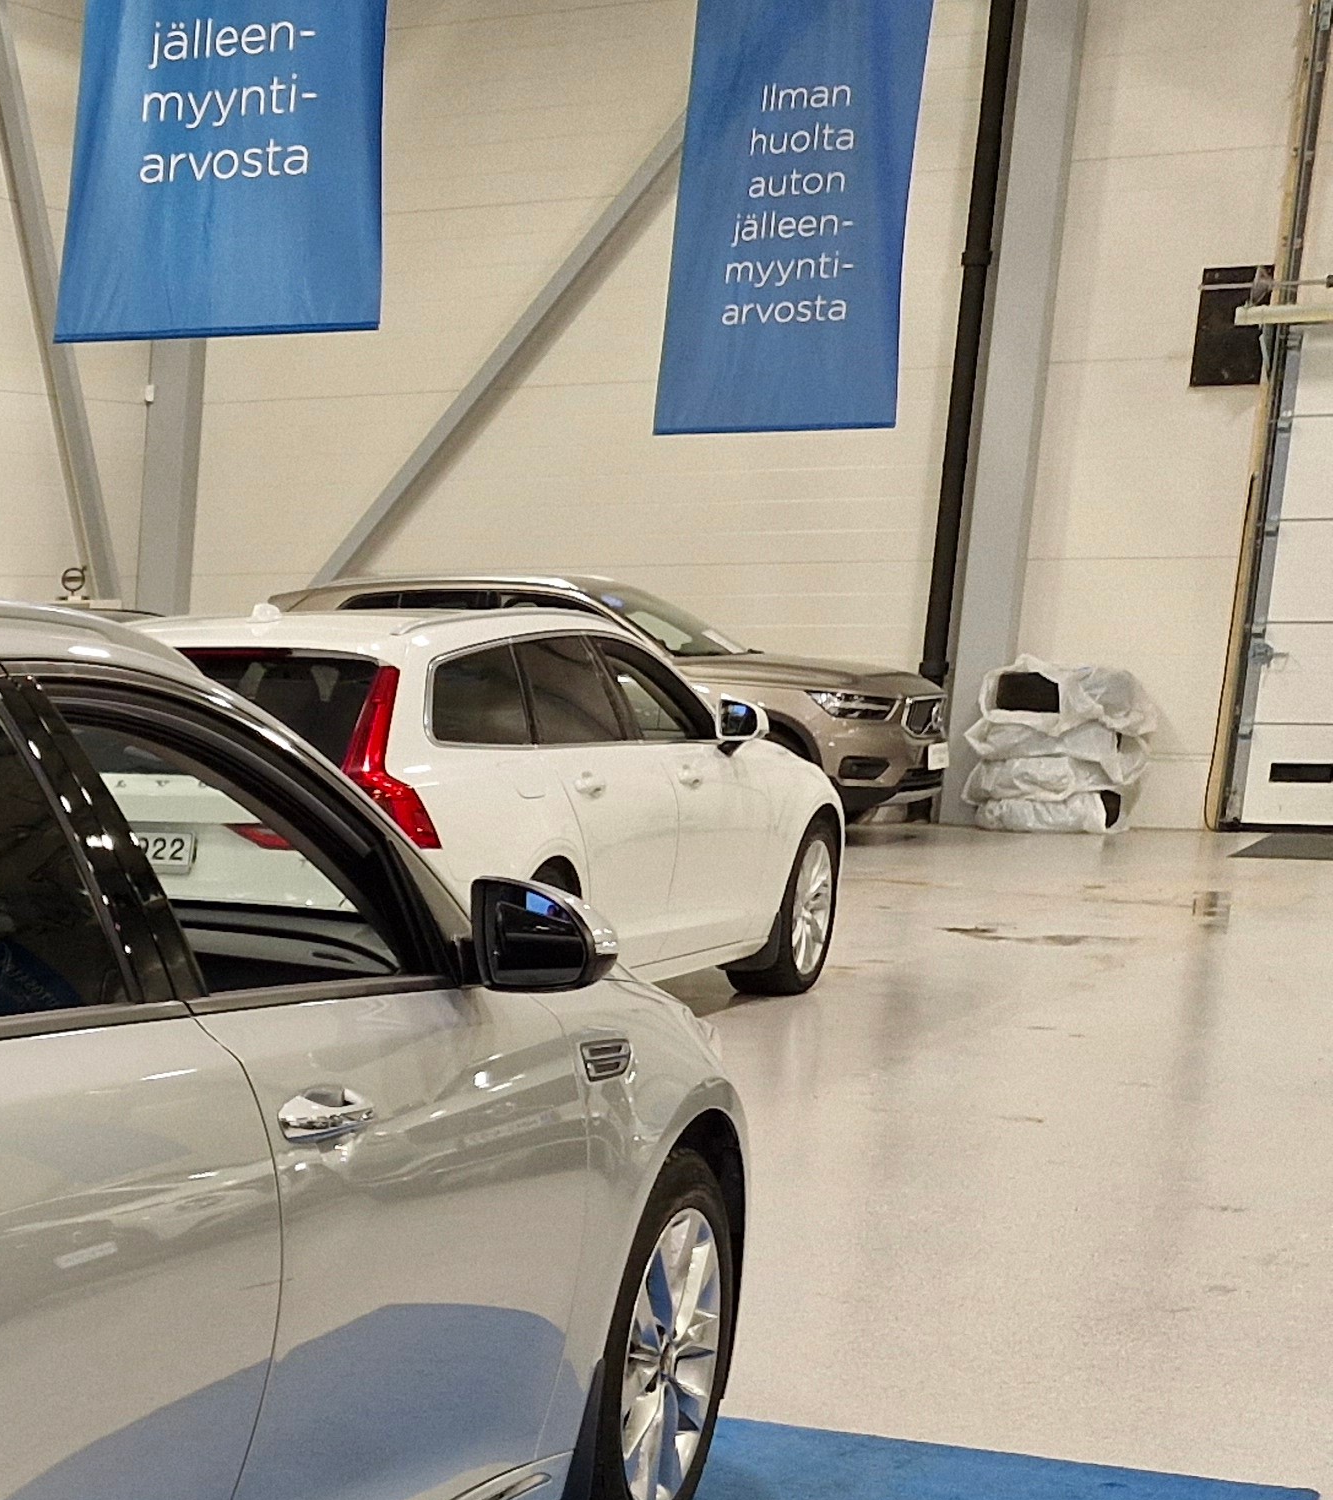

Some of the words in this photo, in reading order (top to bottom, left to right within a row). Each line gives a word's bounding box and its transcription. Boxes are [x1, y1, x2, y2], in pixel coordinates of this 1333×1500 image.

[148, 18, 316, 69] jälleen-
[141, 73, 318, 128] myynti-
[761, 83, 852, 112] Ilman
[749, 122, 855, 156] huolta
[139, 139, 310, 184] arvosta
[748, 169, 845, 198] auton
[731, 211, 854, 247] jälleen-
[725, 251, 854, 288] myynti-
[721, 295, 847, 325] arvosta
